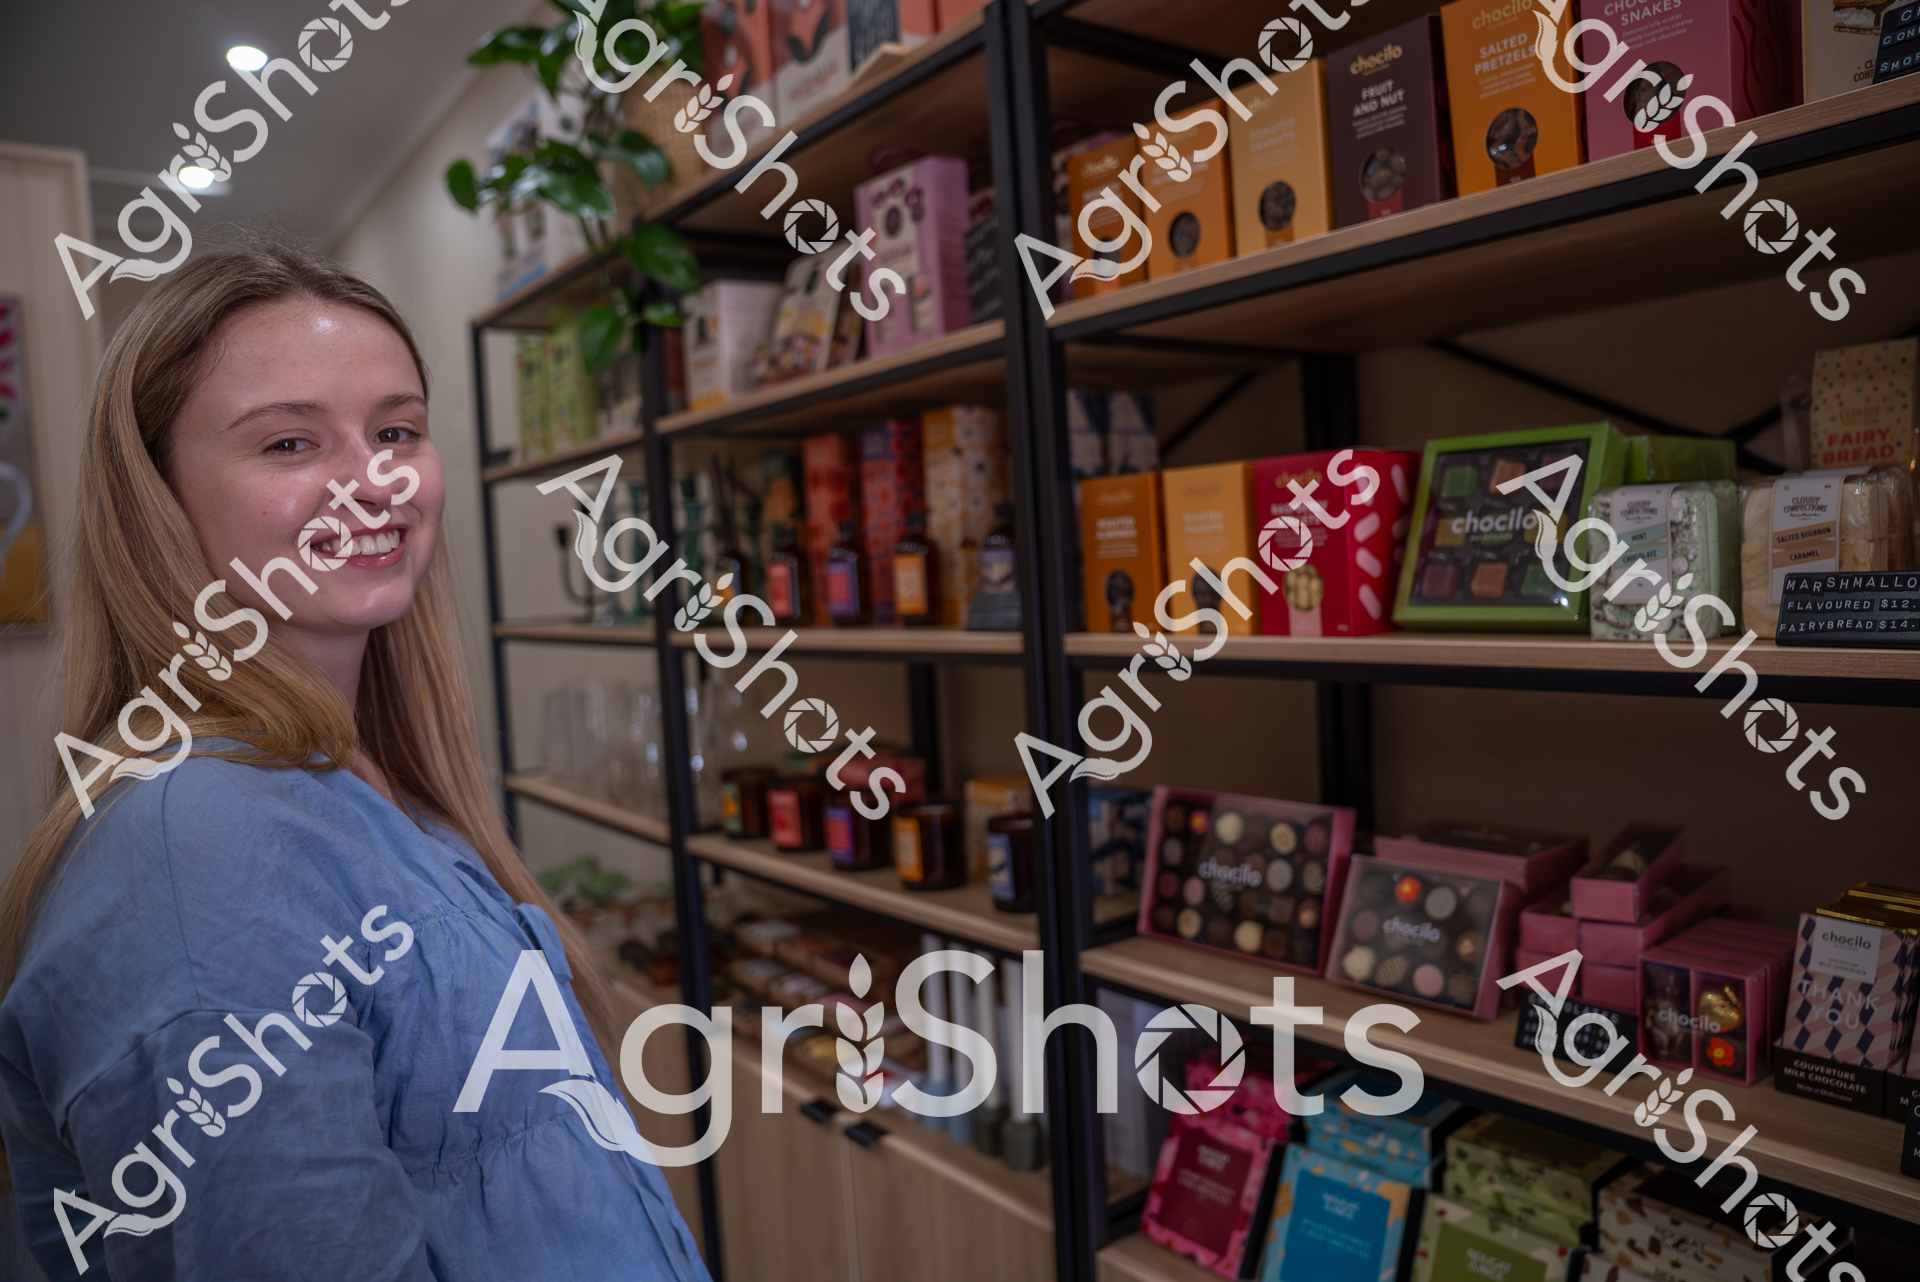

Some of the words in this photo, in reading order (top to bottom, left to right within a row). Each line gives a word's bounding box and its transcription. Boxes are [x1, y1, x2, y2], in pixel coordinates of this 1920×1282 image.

[1604, 0, 1648, 16] CHO
[1621, 0, 1682, 26] SNAKES
[1480, 32, 1528, 59] SALTED
[1883, 26, 1920, 45] CON
[1474, 44, 1536, 76] PRETZELS
[1361, 79, 1395, 101] FRUIT
[1353, 98, 1379, 118] AND
[1380, 88, 1405, 108] NUT
[1827, 426, 1890, 448] FAIRY
[1823, 444, 1895, 466] BREAD
[1783, 504, 1828, 514] CONFECTIONS
[1792, 496, 1821, 506] CLOUDY
[1451, 506, 1538, 535] chocilo
[1631, 532, 1647, 542] MINT
[1776, 531, 1800, 544] SALTED
[1801, 526, 1832, 539] BOURBON
[1622, 549, 1657, 564] CHOCOLATE
[1789, 550, 1820, 561] CARAMEL
[1786, 576, 1918, 592] MARSHMALLO
[1787, 600, 1871, 610] FLAVOURED
[1780, 619, 1874, 633] FAIRYBREAD
[1822, 930, 1872, 950] chocilo
[1801, 979, 1881, 1012] THANK
[1658, 1007, 1722, 1034] chocilo
[1812, 1003, 1860, 1030] YOU
[1783, 1066, 1806, 1080] MILK
[1808, 1072, 1867, 1095] CHOCOLATE
[1793, 1059, 1857, 1082] COUVERTURE
